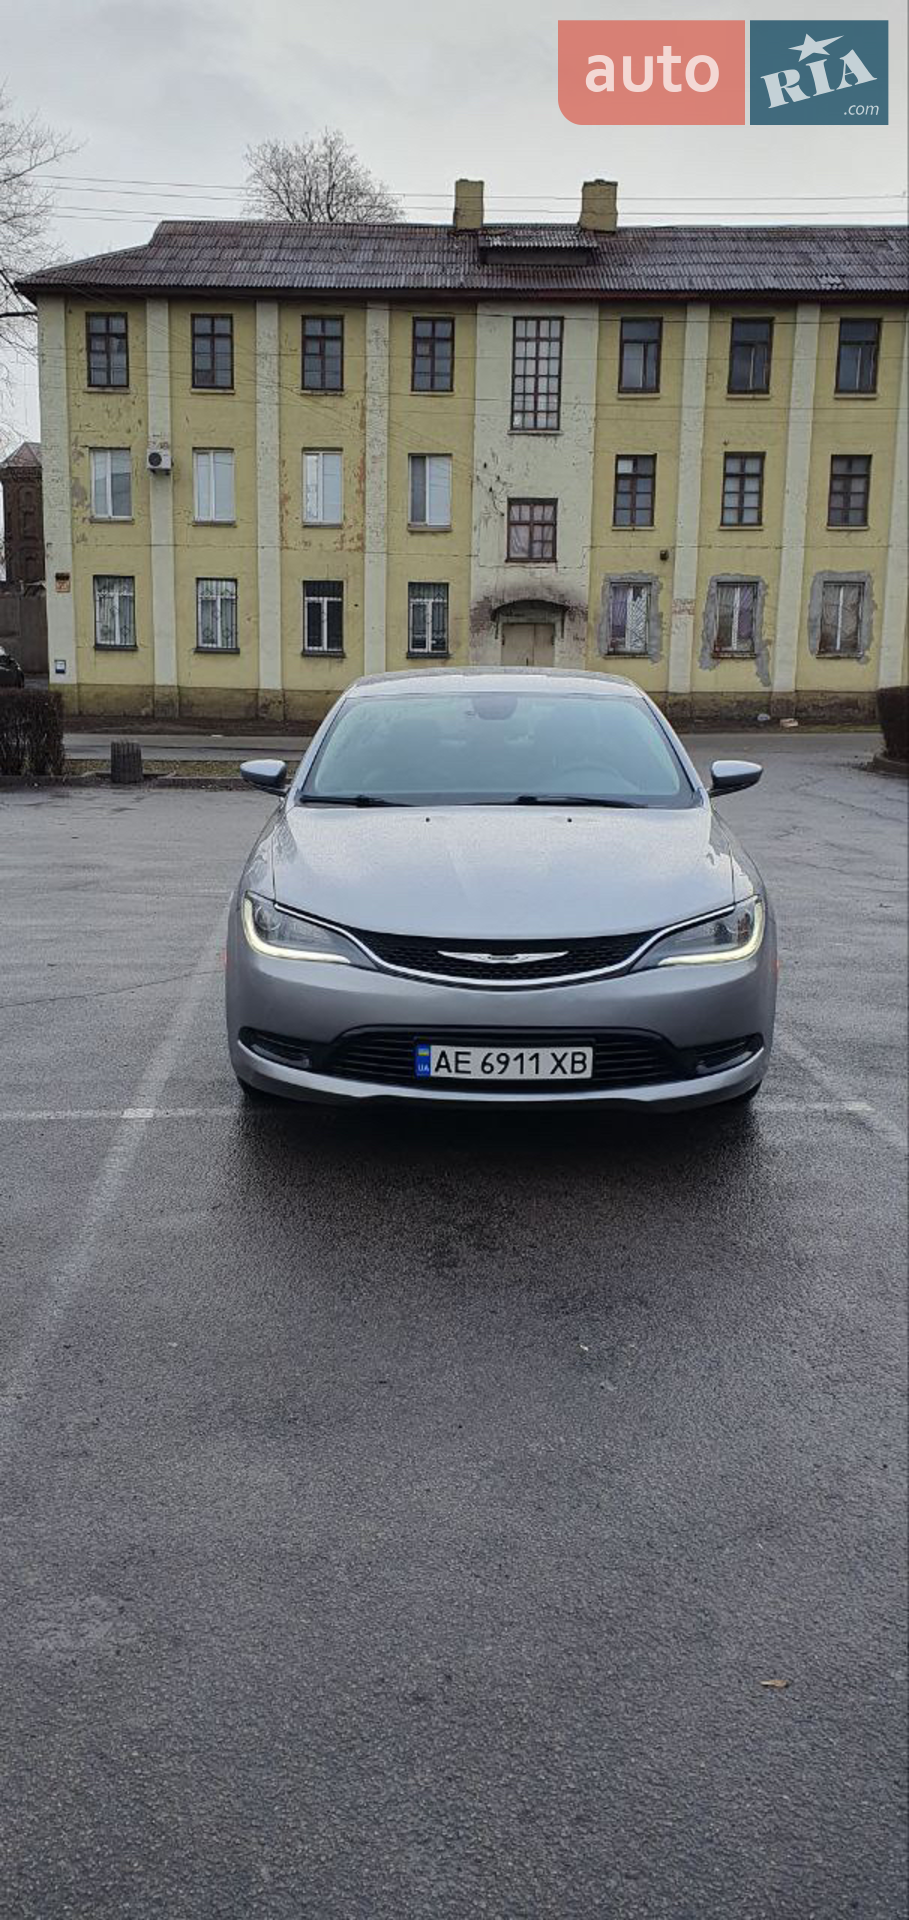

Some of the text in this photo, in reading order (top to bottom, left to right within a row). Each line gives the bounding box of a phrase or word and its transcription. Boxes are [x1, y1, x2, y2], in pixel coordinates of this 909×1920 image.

[434, 1050, 587, 1075] AE 6911 XB
